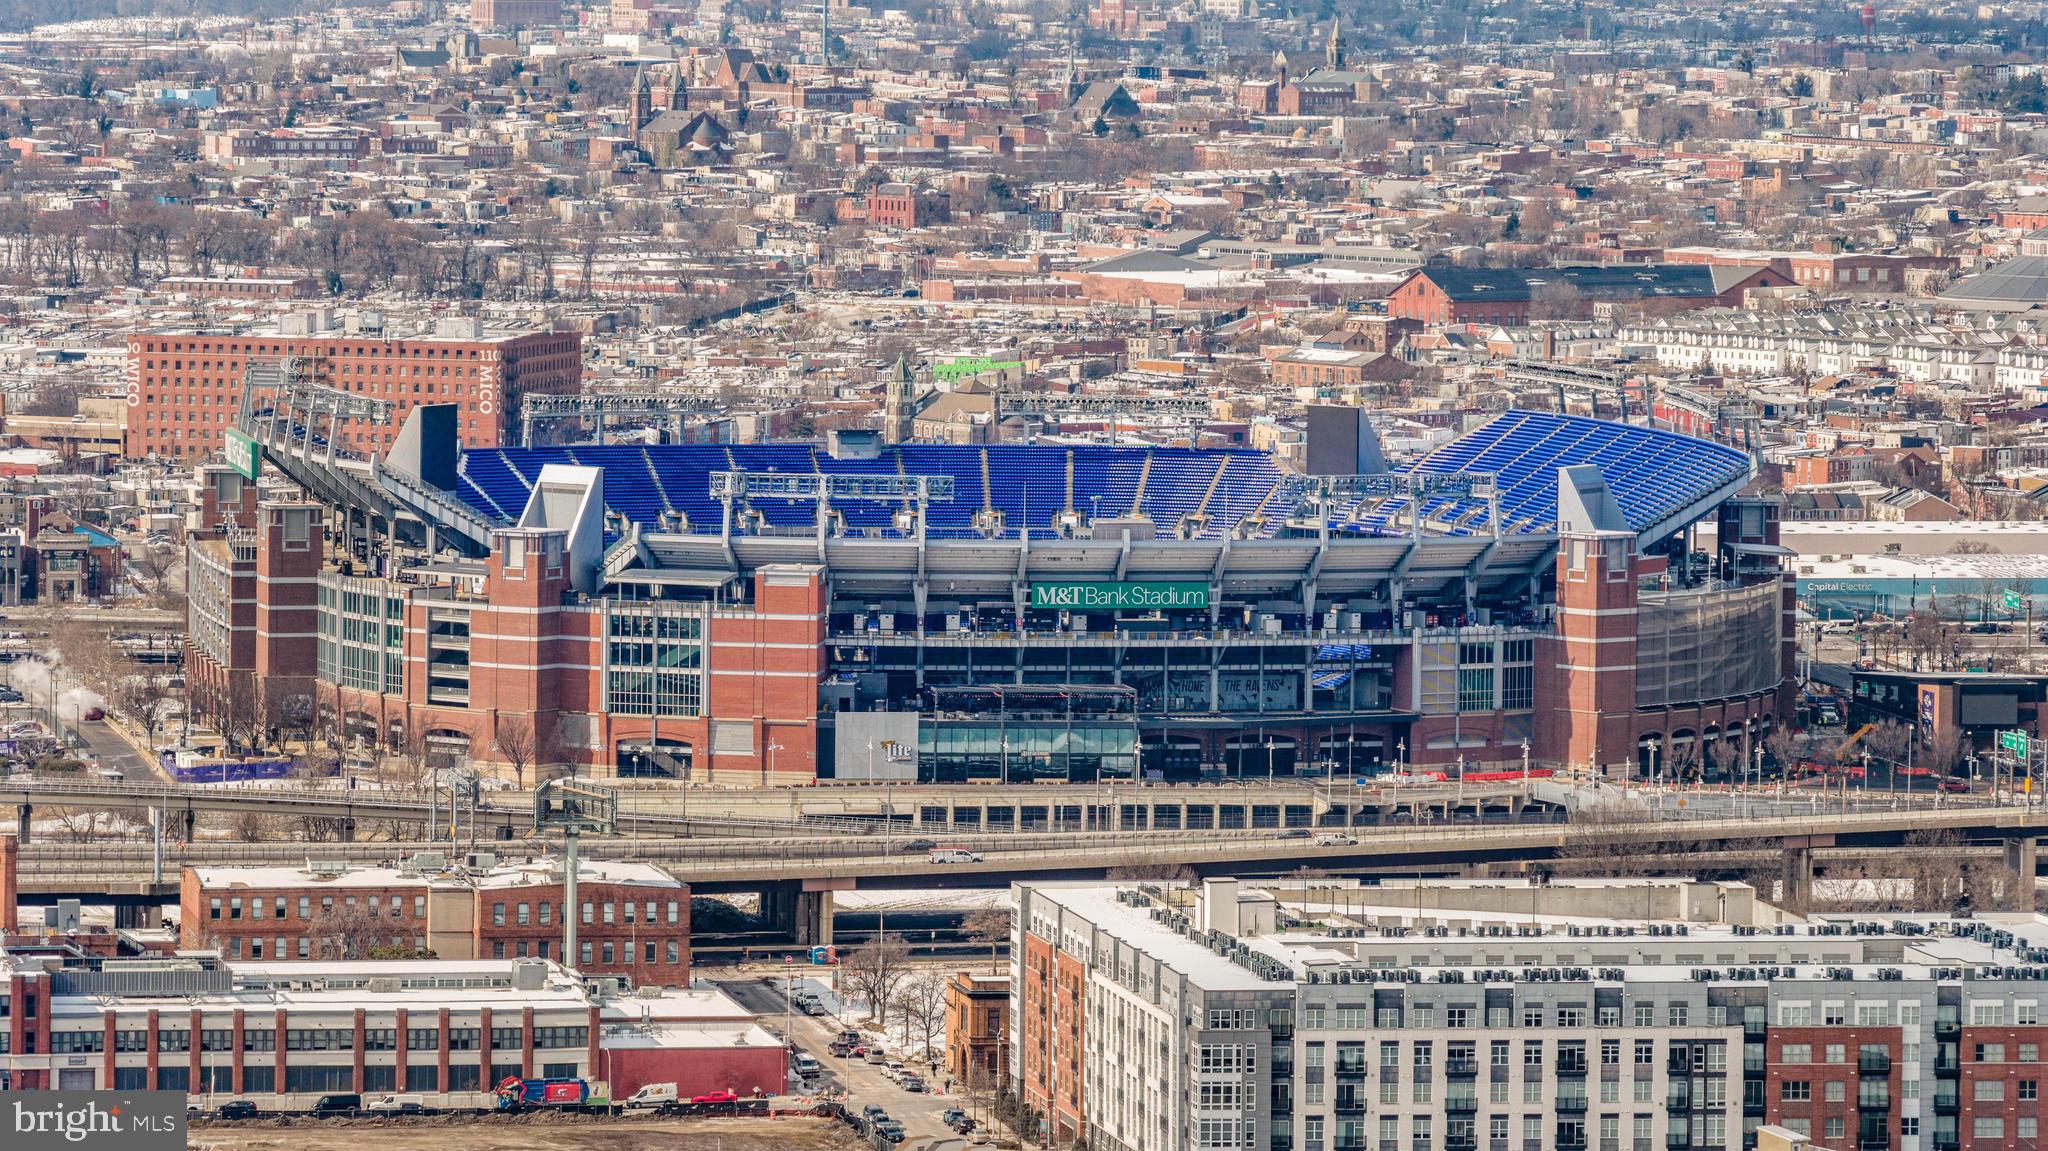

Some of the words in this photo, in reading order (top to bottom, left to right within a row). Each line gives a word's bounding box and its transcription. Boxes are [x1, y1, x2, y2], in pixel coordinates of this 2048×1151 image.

[1807, 582, 1839, 591] Capital
[1840, 582, 1873, 591] Electric
[1037, 586, 1083, 605] M&T
[1085, 586, 1130, 605] Bank
[1132, 586, 1204, 605] Stadium
[1181, 679, 1206, 692] HOME
[1224, 679, 1242, 692] THE
